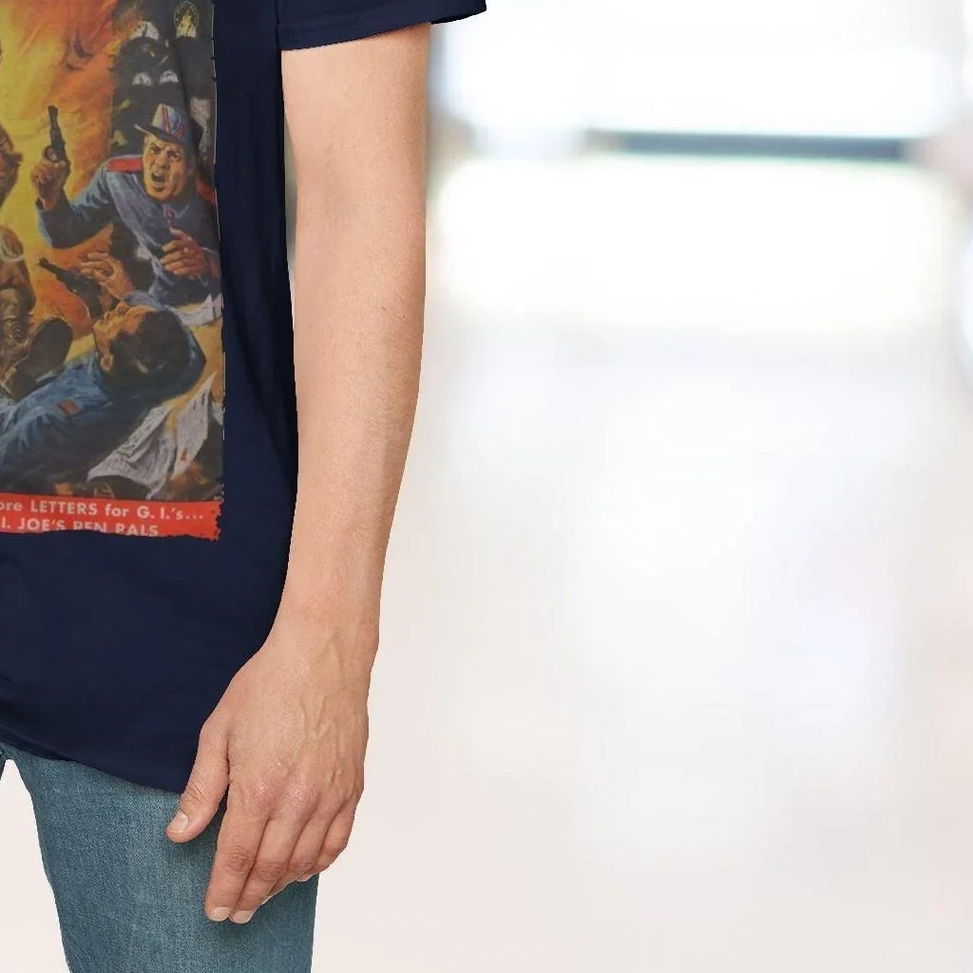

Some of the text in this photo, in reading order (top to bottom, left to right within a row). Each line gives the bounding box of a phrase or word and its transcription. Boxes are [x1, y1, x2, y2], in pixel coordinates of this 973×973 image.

[30, 499, 98, 515] LETTERS
[104, 503, 129, 517] for
[17, 517, 66, 531] JOE'S
